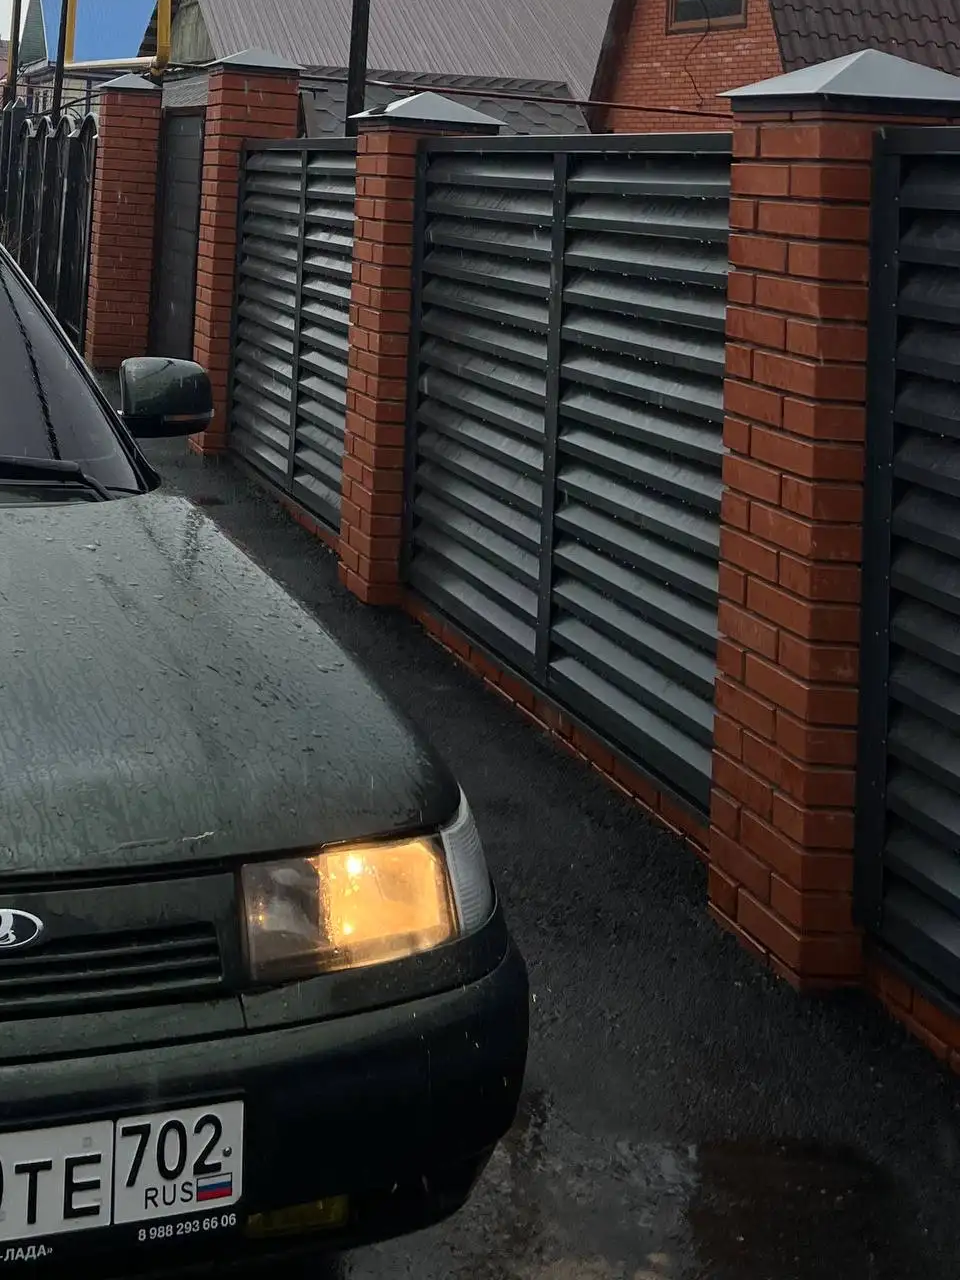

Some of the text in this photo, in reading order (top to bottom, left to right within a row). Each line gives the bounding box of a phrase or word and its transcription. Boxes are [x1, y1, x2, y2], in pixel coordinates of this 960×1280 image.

[121, 1114, 222, 1188] 702
[144, 1181, 194, 1210] RUS
[138, 1213, 237, 1241] 8 988 293 66 06
